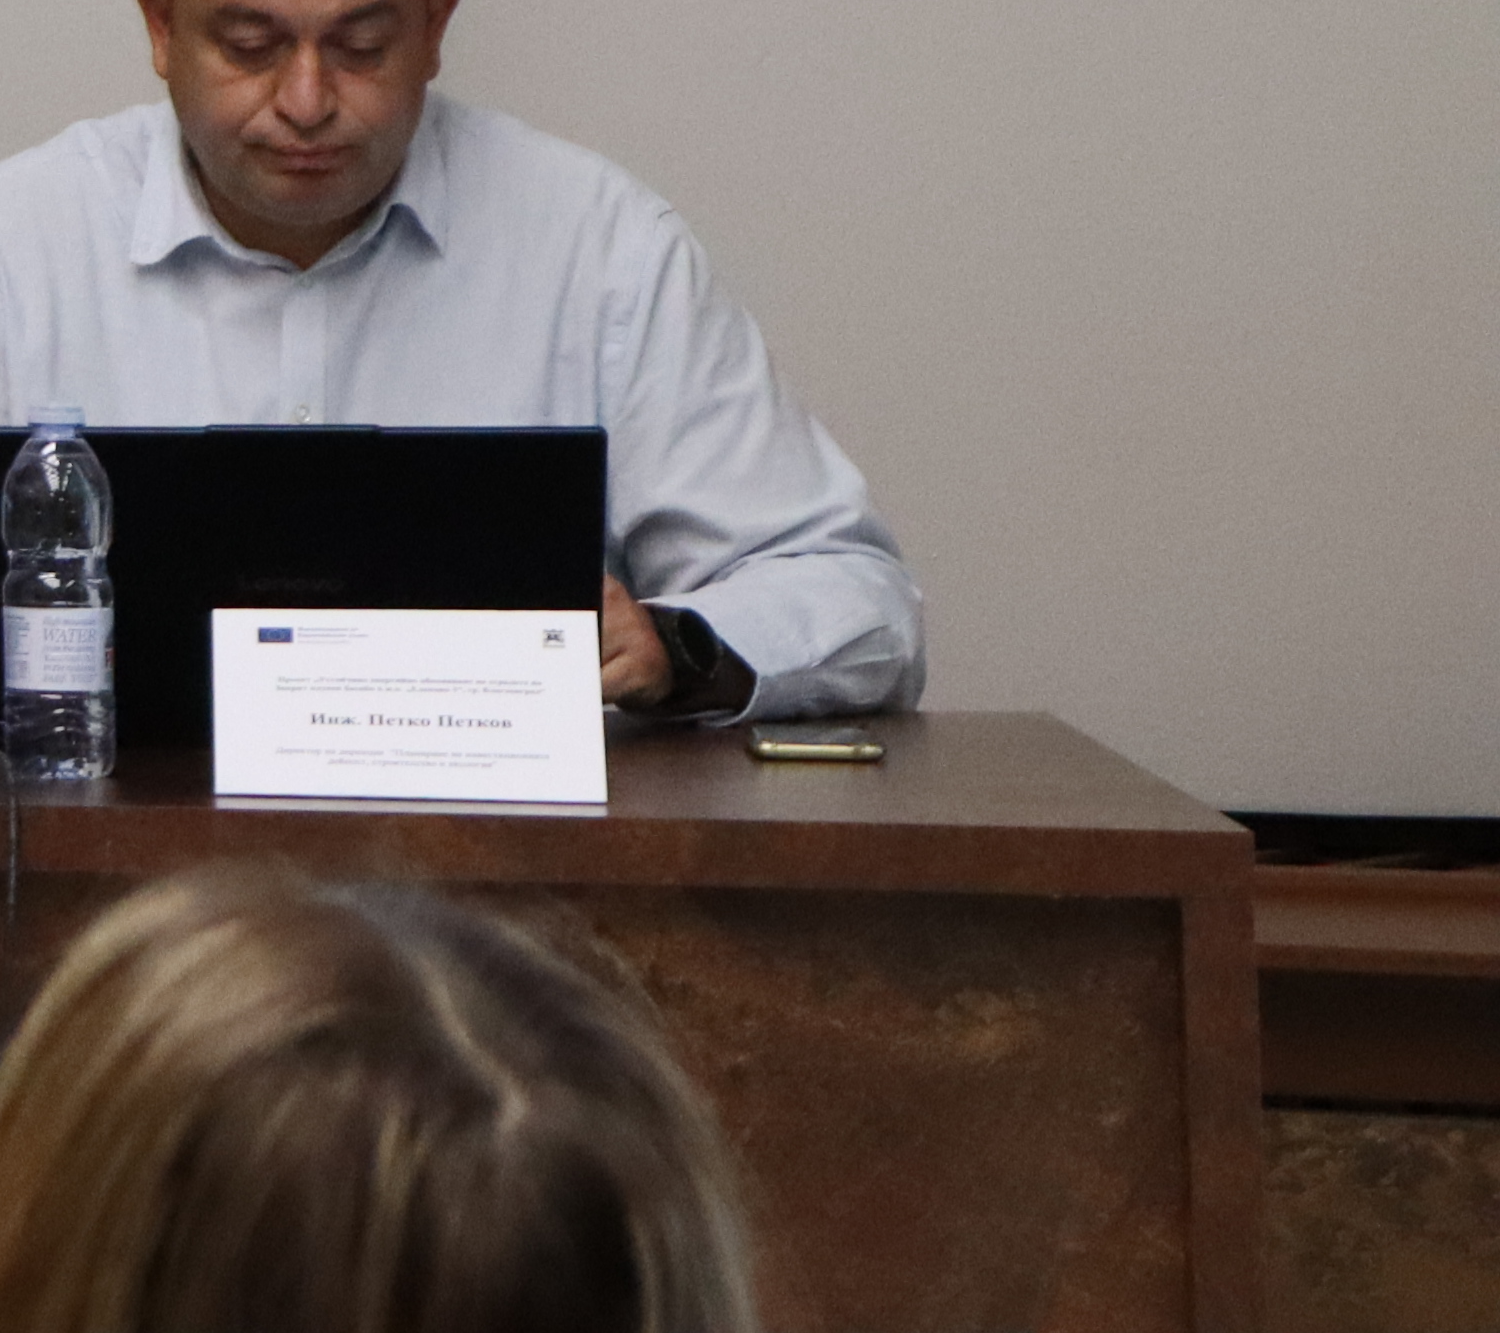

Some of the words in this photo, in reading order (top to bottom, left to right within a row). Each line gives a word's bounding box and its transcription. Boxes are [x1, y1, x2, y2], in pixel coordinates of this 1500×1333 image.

[310, 712, 363, 726] Инж.
[368, 713, 432, 728] Петко
[437, 714, 514, 729] Петков
